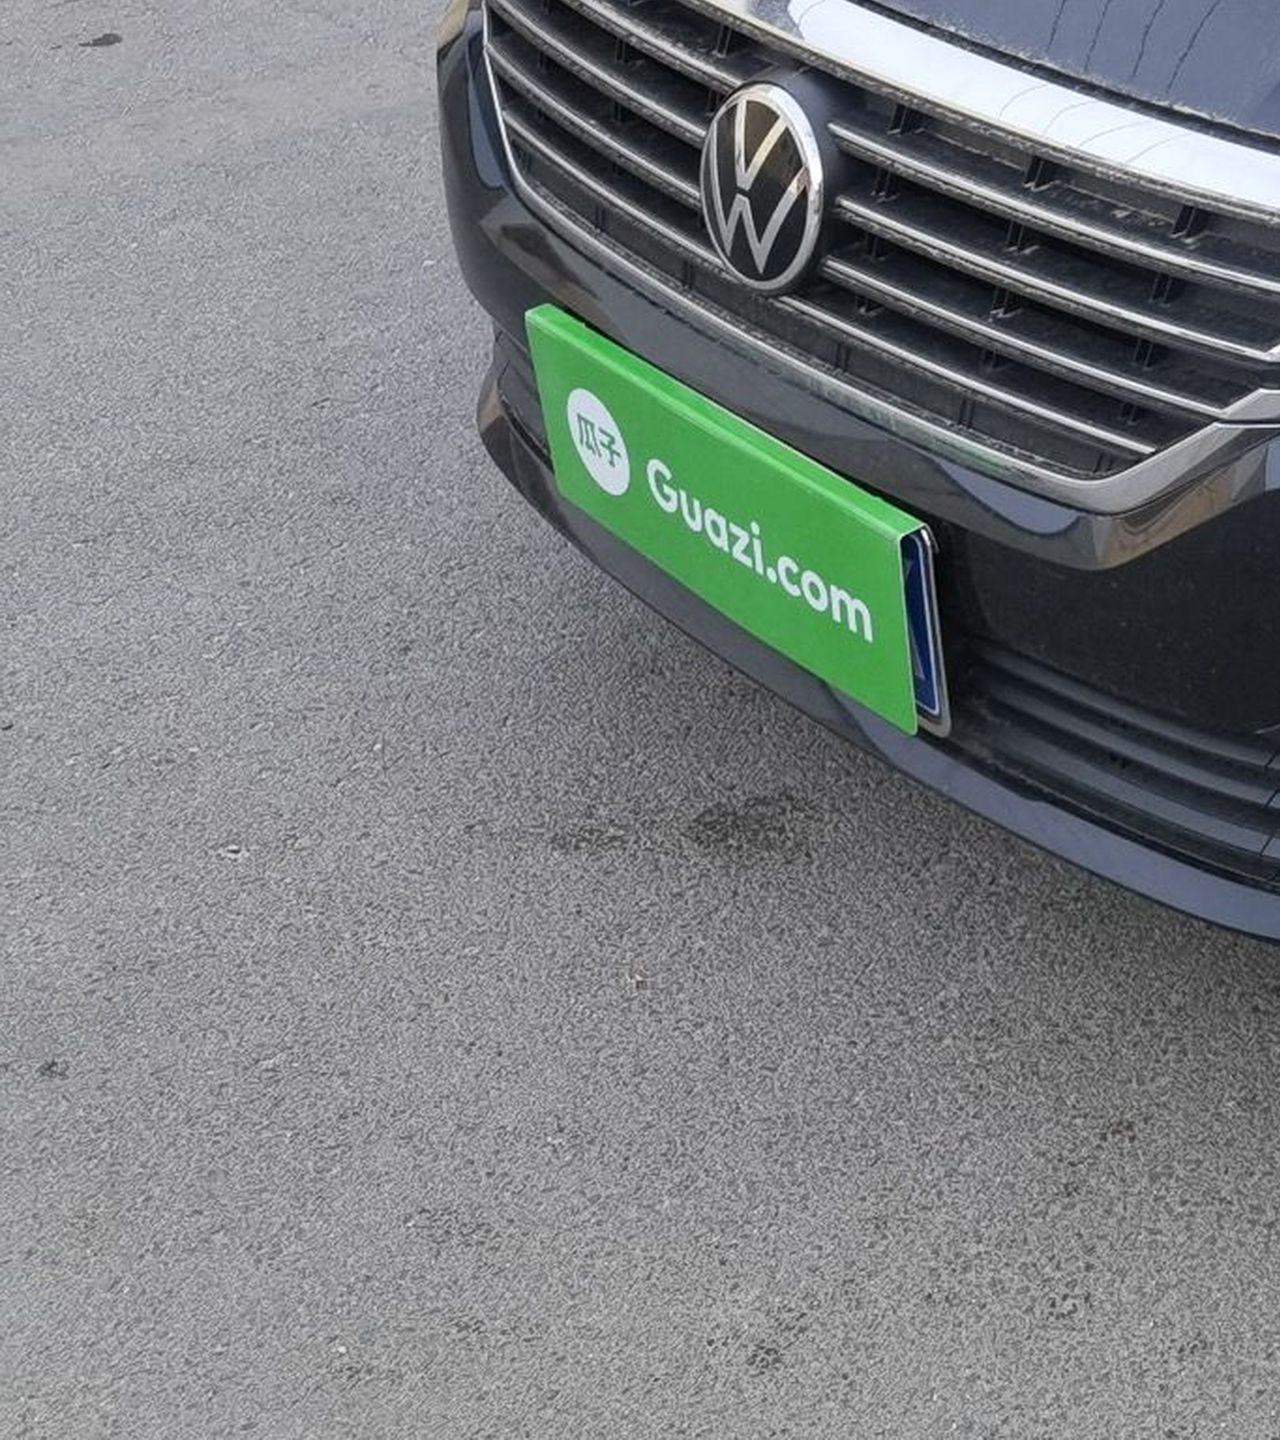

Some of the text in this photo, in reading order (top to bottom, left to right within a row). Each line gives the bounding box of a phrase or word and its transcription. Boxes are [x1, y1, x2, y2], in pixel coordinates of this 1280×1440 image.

[708, 94, 812, 275] VW
[576, 412, 622, 469] 瓜子
[646, 458, 874, 644] Guazi.com
